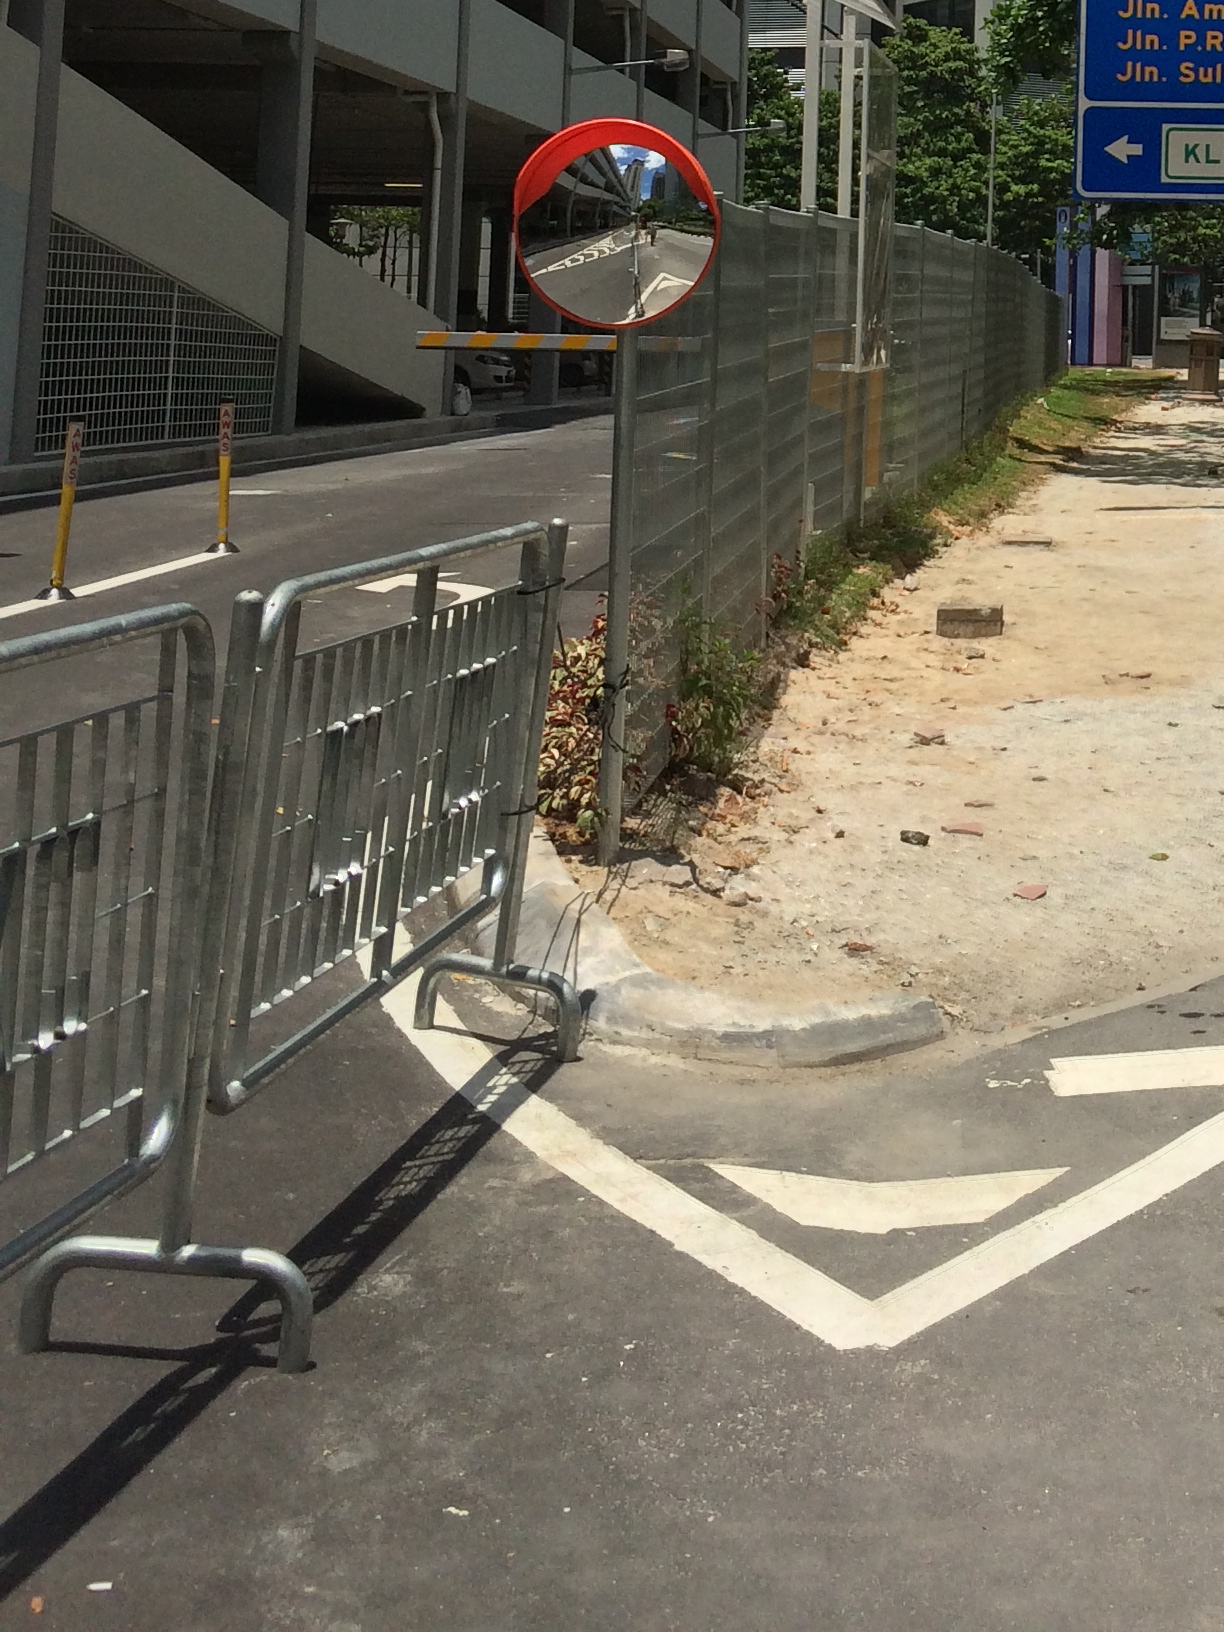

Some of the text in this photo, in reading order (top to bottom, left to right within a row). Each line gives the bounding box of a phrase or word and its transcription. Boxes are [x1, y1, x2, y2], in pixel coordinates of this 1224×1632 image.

[1116, 29, 1168, 51] Jln.
[1116, 61, 1167, 83] Jln.
[221, 408, 231, 452] AWAS
[69, 428, 81, 480] AWAS
